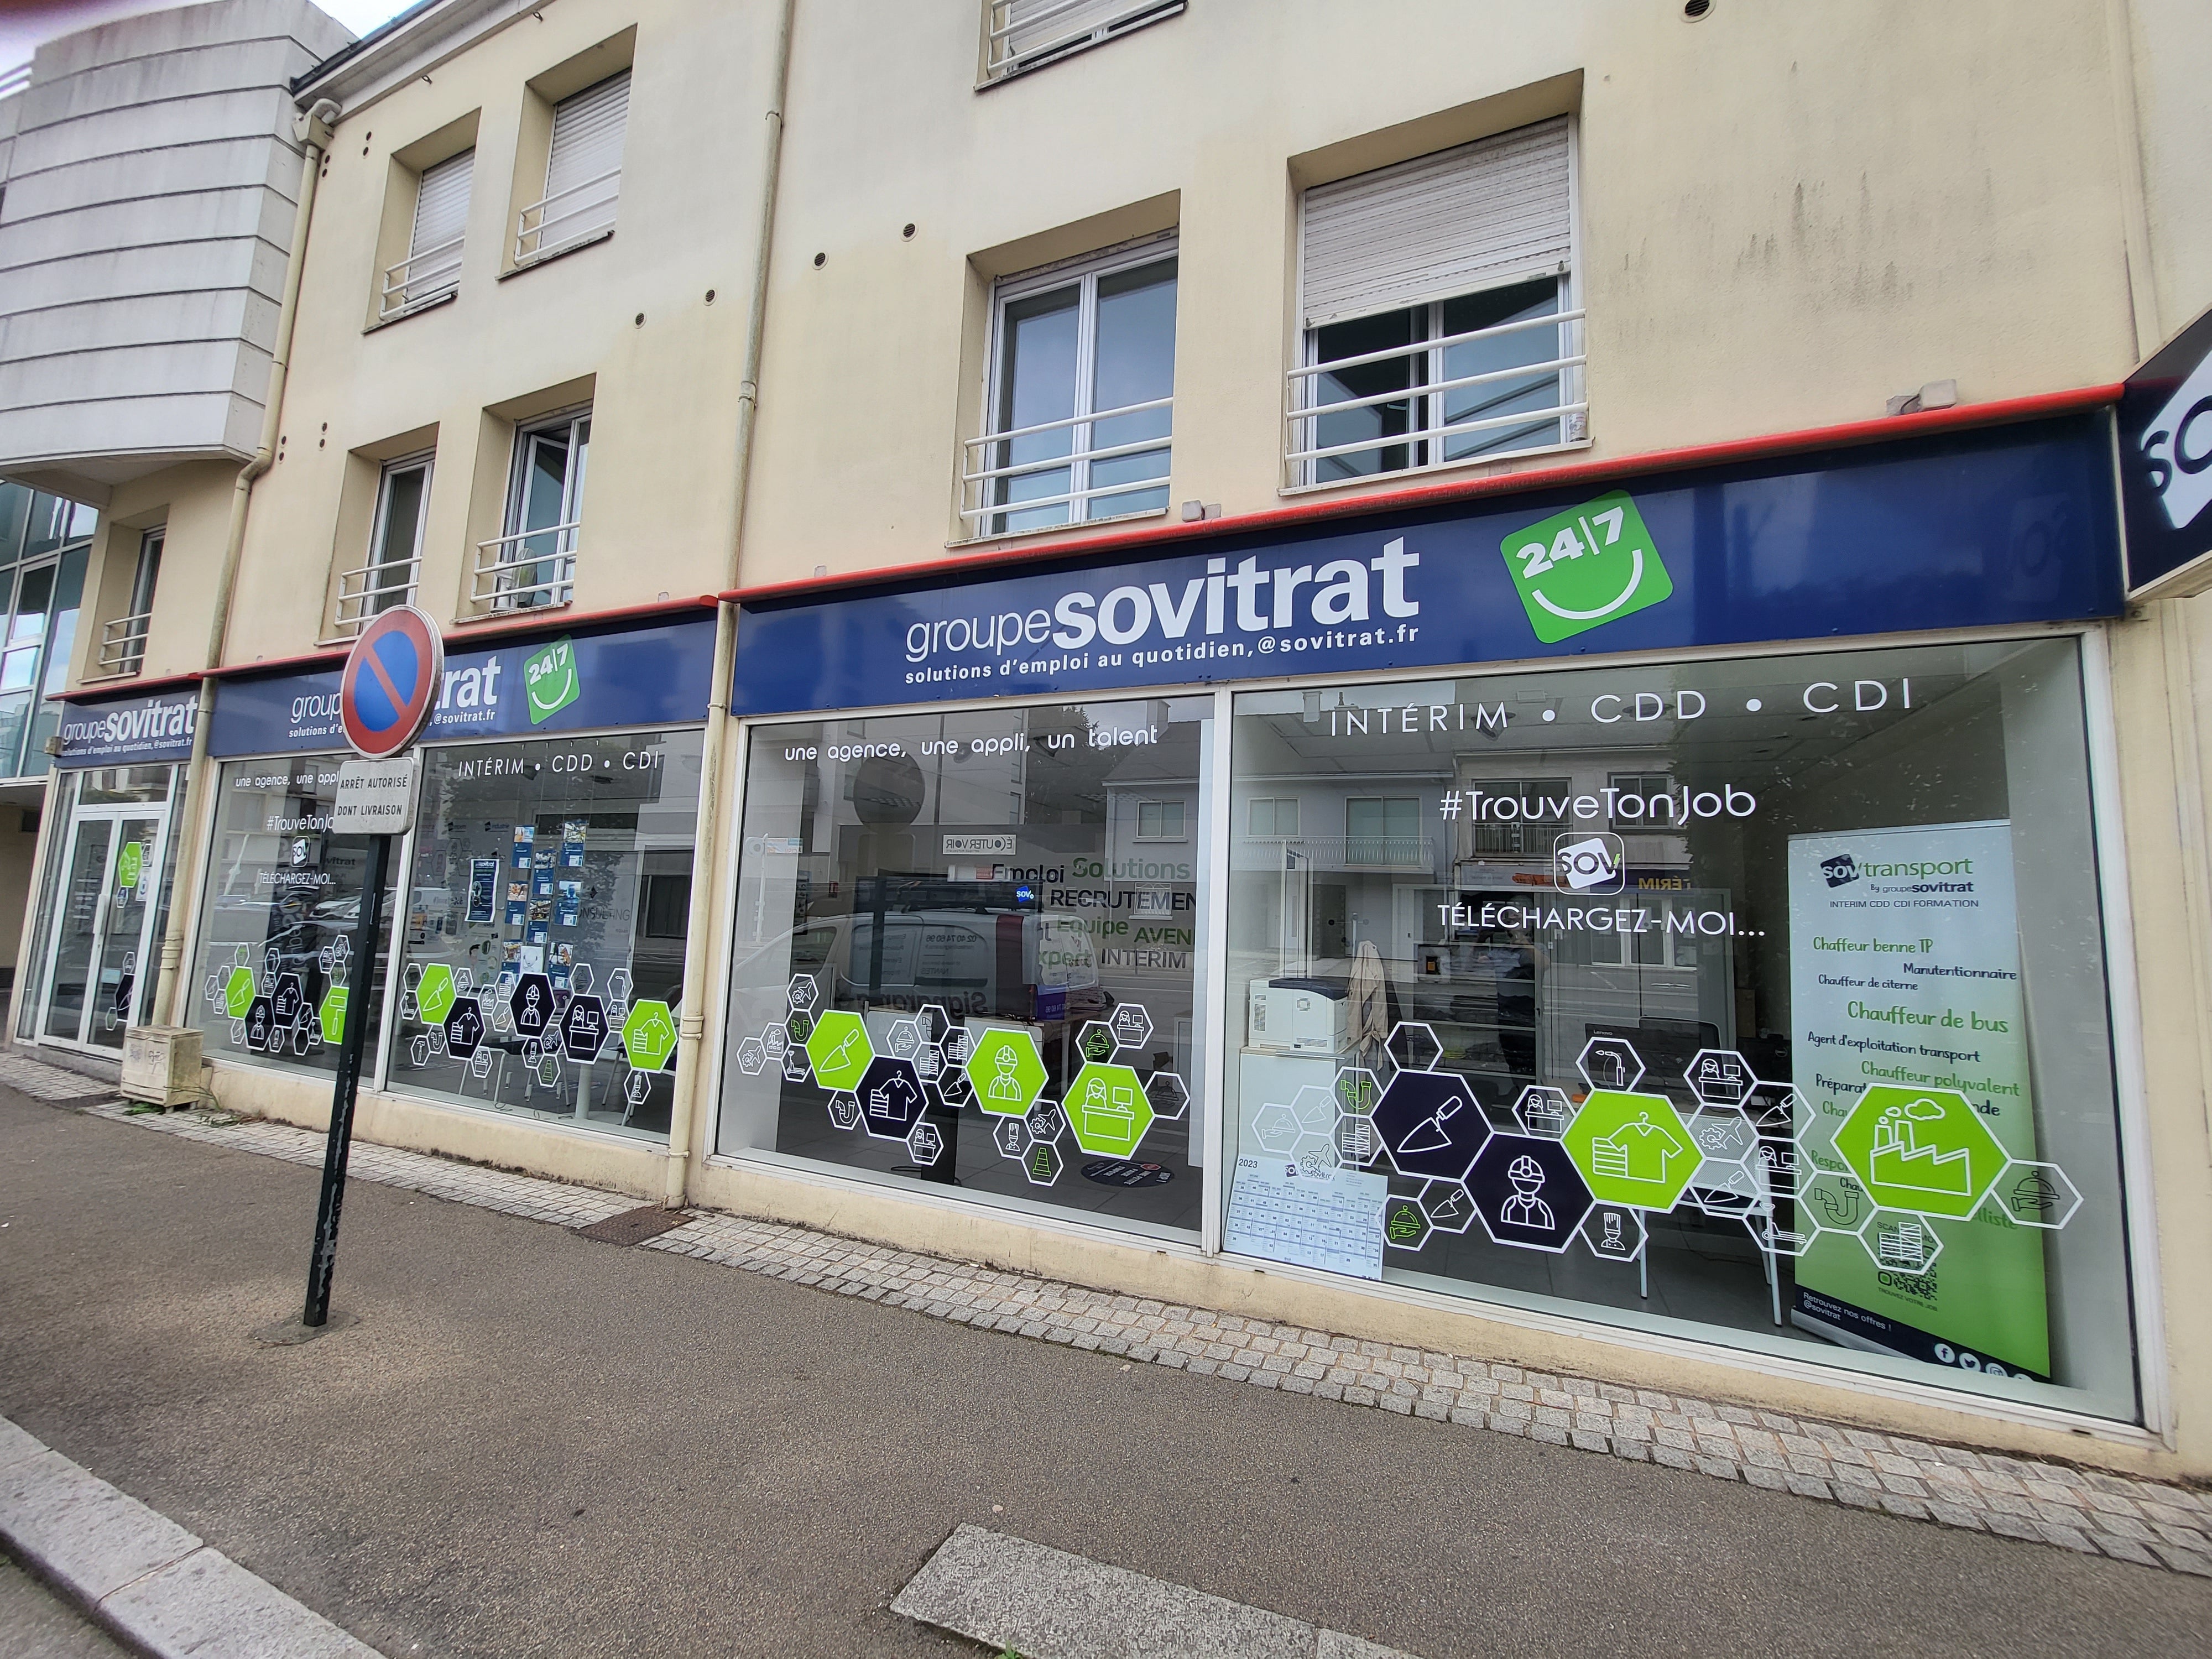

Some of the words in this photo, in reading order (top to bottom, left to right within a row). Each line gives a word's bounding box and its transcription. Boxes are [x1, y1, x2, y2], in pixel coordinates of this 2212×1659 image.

[905, 663, 992, 685] solutions
[1000, 653, 1088, 679] d'emploi
[1098, 653, 1123, 668] au
[1331, 701, 1509, 736] INTÉRIM
[1591, 690, 1706, 724] CDD
[1802, 677, 1911, 714] CDI
[289, 726, 327, 738] solutions
[785, 744, 817, 760] une
[827, 740, 907, 763] agence,
[921, 738, 958, 757] une
[971, 733, 1030, 757] appli,
[1047, 733, 1075, 749] un
[1088, 724, 1158, 748] talent
[458, 755, 525, 777] INTÉRIM
[552, 754, 593, 773] CDD
[623, 750, 659, 770] CDI
[236, 777, 251, 787] une
[255, 775, 290, 789] agence,
[296, 774, 314, 785] une
[317, 770, 339, 786] appl
[340, 776, 364, 789] ARRÊT
[367, 774, 408, 788] AUTORISÉ
[337, 806, 357, 816] DONT
[361, 805, 403, 816] LIVRAISON
[1439, 784, 1756, 825] #TrouveTonJob
[267, 814, 335, 832] #TrouveTonJo
[1072, 858, 1190, 879] Solutions
[1871, 884, 1880, 893] By
[1051, 890, 1196, 910] RECRUTEMEN
[1057, 916, 1129, 940] Equipe
[1134, 927, 1194, 945] AVEN
[1873, 938, 1916, 953] benne
[1918, 938, 1933, 953] TP
[1102, 948, 1186, 968] INTERIM
[1818, 974, 1866, 987] Chauffeur
[1867, 977, 1880, 988] de
[1882, 979, 1918, 990] citerne
[1903, 963, 2017, 980] Manutentionnaire
[1848, 1000, 1937, 1025] Chauffeur
[1940, 1008, 1964, 1029] de
[1971, 1011, 2008, 1033] bus
[1808, 1031, 1836, 1047] Agent
[1838, 1034, 1916, 1055] d'exploitation
[1919, 1045, 1981, 1064] transport
[1815, 1073, 1866, 1095] Préparat
[1861, 1060, 1931, 1083] Chauffeur
[1934, 1073, 2020, 1096] polyvalent
[1239, 1159, 1258, 1168] 2023
[1803, 1300, 1841, 1321] @sovitrat
[1803, 1292, 1841, 1313] Retrouvez
[1844, 1309, 1859, 1319] nos
[1861, 1315, 1886, 1330] offres
